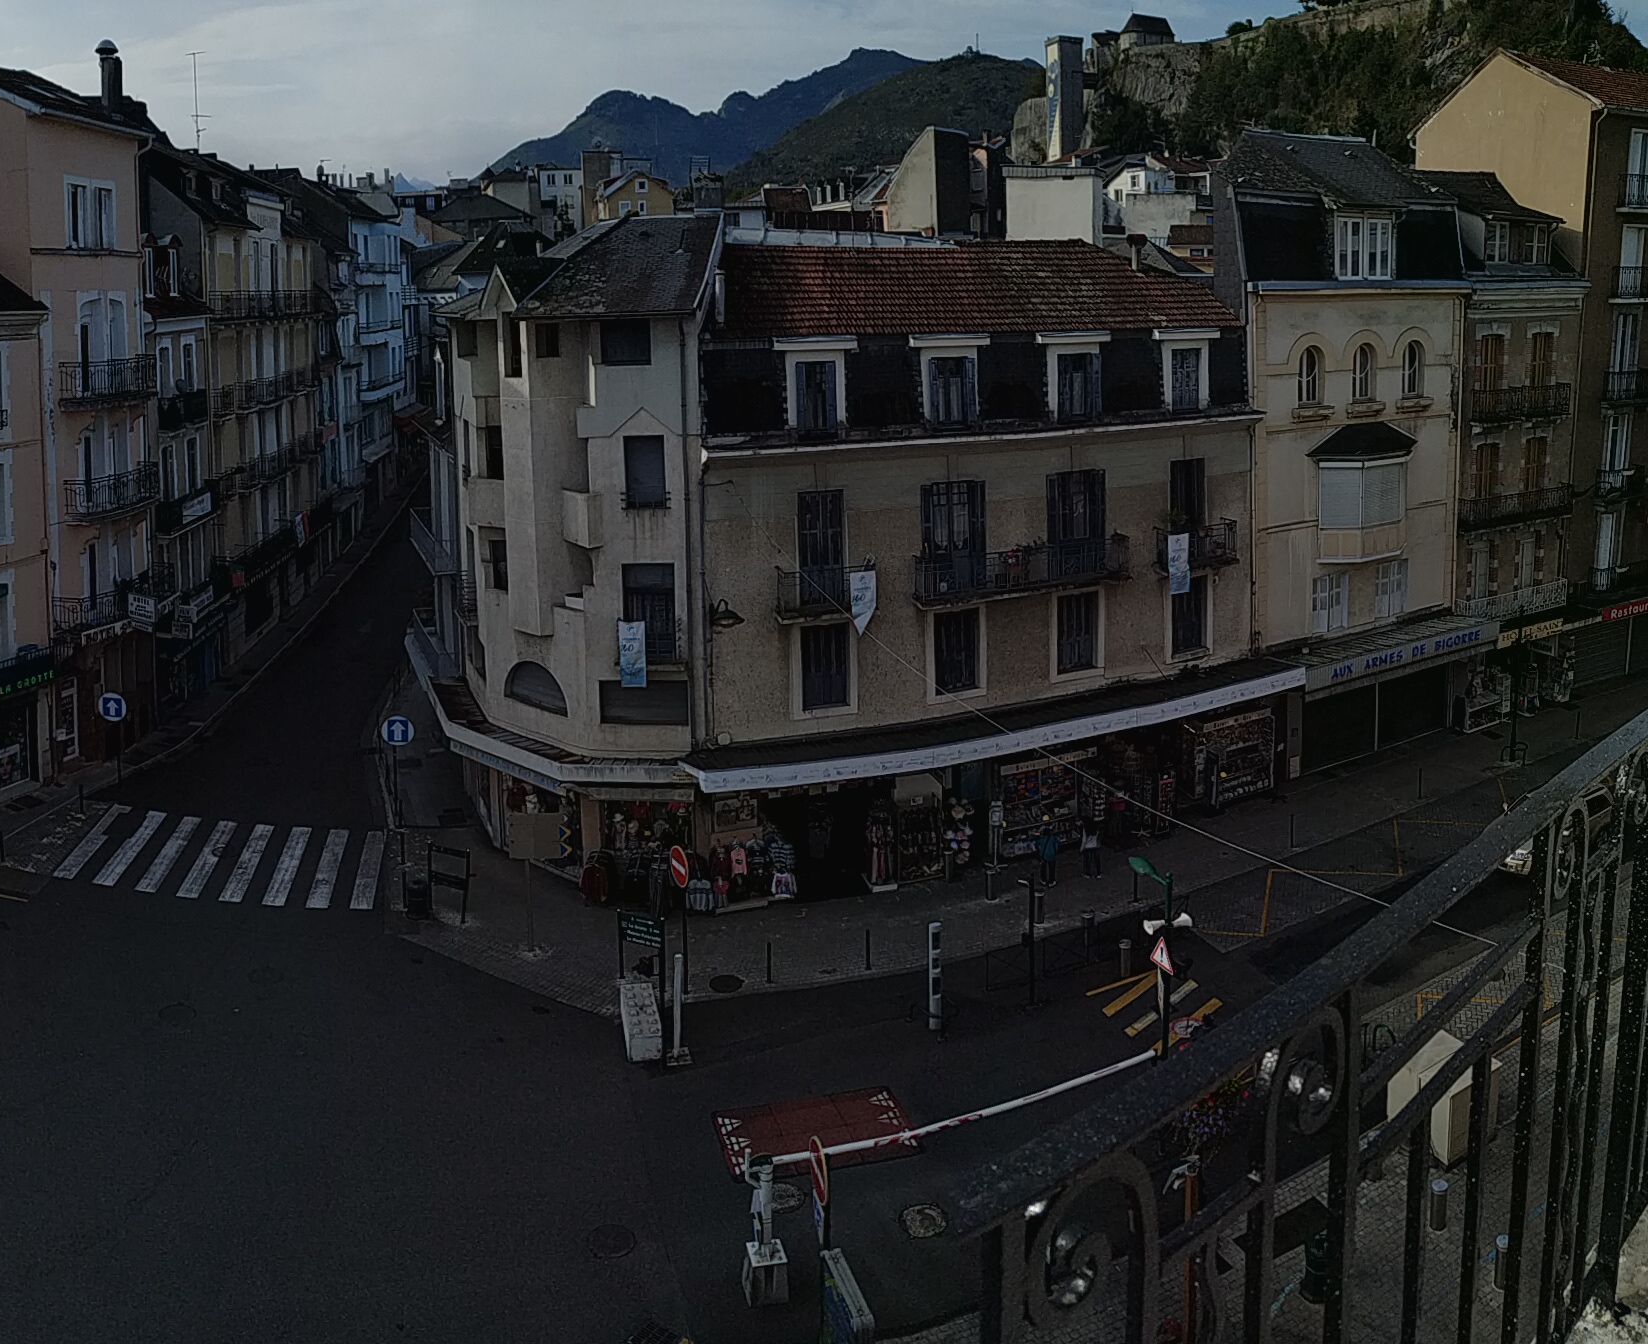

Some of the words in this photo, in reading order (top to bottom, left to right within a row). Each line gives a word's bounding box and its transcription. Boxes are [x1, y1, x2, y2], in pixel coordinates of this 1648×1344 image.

[1331, 664, 1353, 680] AUX
[1363, 651, 1403, 671] ARMES
[1411, 644, 1426, 658] DE
[1435, 629, 1481, 652] BIGORRE
[0, 684, 12, 695] LA
[17, 669, 55, 689] GROTTE
